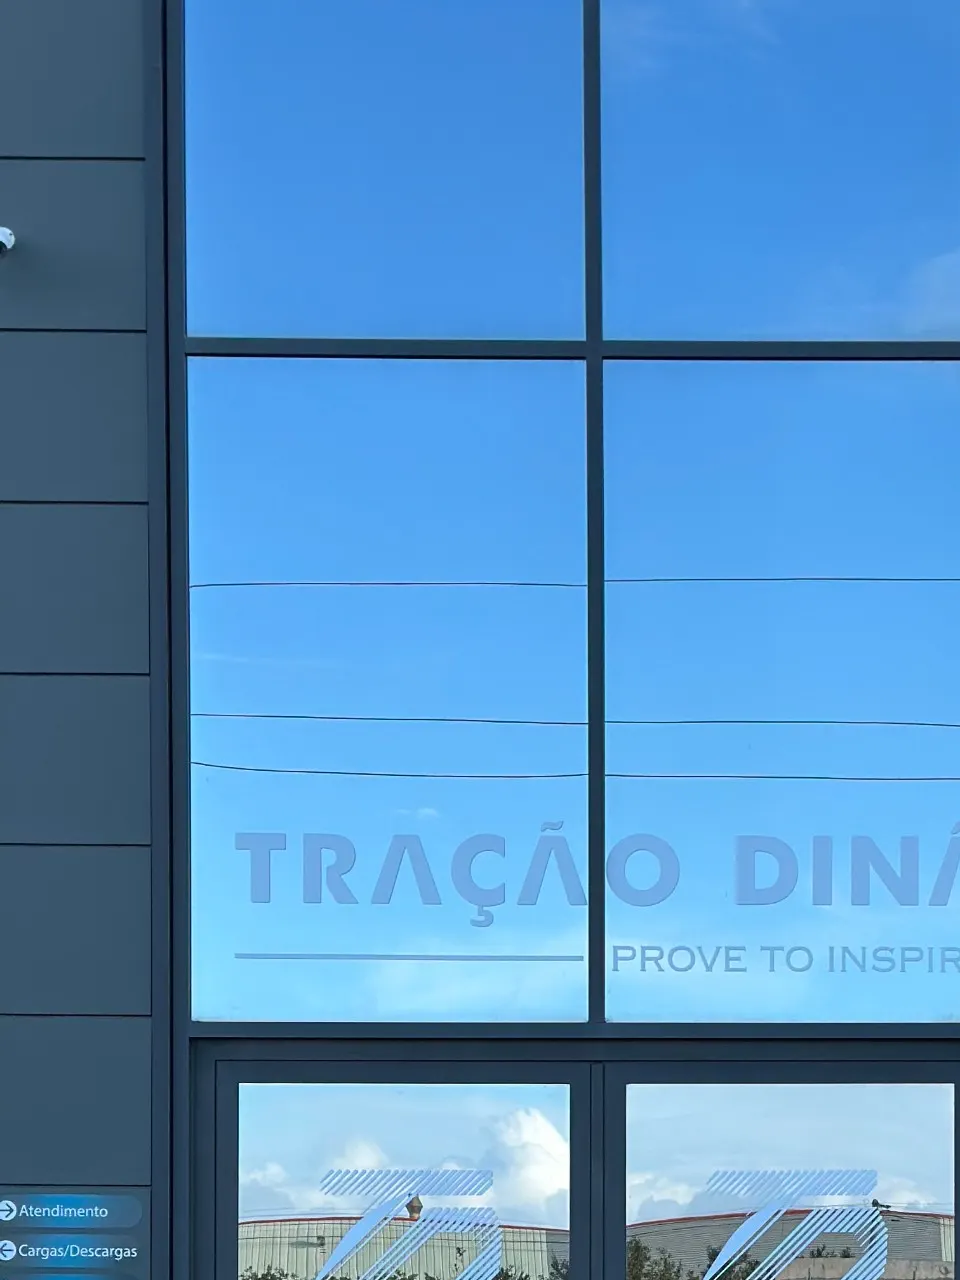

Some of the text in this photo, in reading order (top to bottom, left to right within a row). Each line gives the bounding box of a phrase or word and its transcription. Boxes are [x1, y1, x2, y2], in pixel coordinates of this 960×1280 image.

[234, 819, 680, 927] TRAÇÃO
[612, 945, 747, 972] PROVE
[760, 945, 813, 973] TO
[18, 1204, 108, 1218] Atendimento
[18, 1244, 138, 1261] Cargas/Descargas
